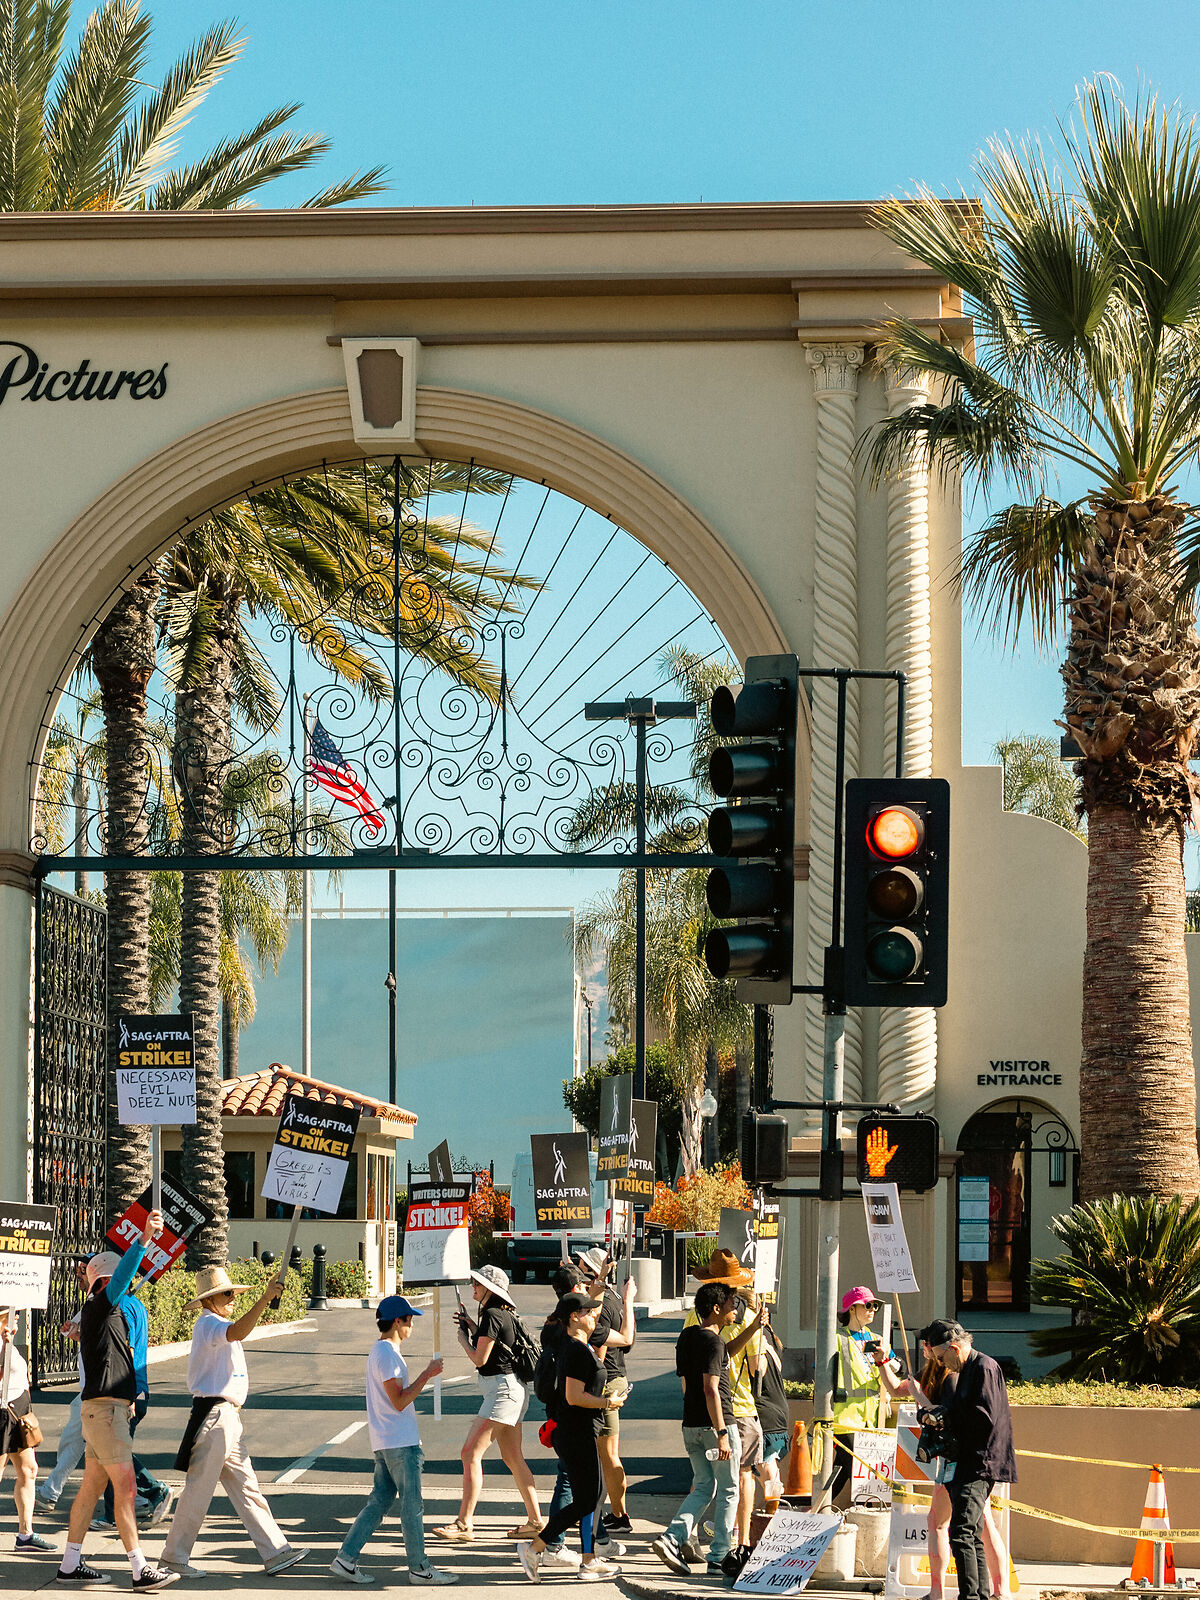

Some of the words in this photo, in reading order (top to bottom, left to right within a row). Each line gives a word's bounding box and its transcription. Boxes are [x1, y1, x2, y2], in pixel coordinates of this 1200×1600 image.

[146, 1042, 162, 1051] ON
[119, 1051, 191, 1066] STRIKE!
[989, 1060, 1050, 1072] VISITOR
[121, 1070, 194, 1084] NECESSARY
[977, 1074, 1062, 1086] ENTRANCE
[140, 1084, 175, 1096] EVIL
[128, 1096, 164, 1108] DEEZ
[168, 1095, 197, 1107] NUTS
[309, 1127, 323, 1137] ON
[279, 1128, 350, 1157] STRIKE!
[598, 1154, 629, 1171] STRIKE!
[412, 1189, 441, 1200] WRITERS
[441, 1188, 466, 1198] GUILD
[169, 1205, 180, 1215] OF
[185, 1204, 206, 1225] GUILD
[409, 1206, 464, 1228] STRIKE!
[537, 1206, 591, 1221] STRIKE!
[13, 1229, 27, 1237] ON
[853, 1461, 894, 1481] IGHT
[778, 1518, 823, 1532] THANKS
[764, 1529, 800, 1544] CLEAR
[905, 1528, 917, 1540] LA
[779, 1558, 816, 1572] LIGHT
[739, 1570, 766, 1584] THE
[766, 1573, 803, 1588] WHEN
